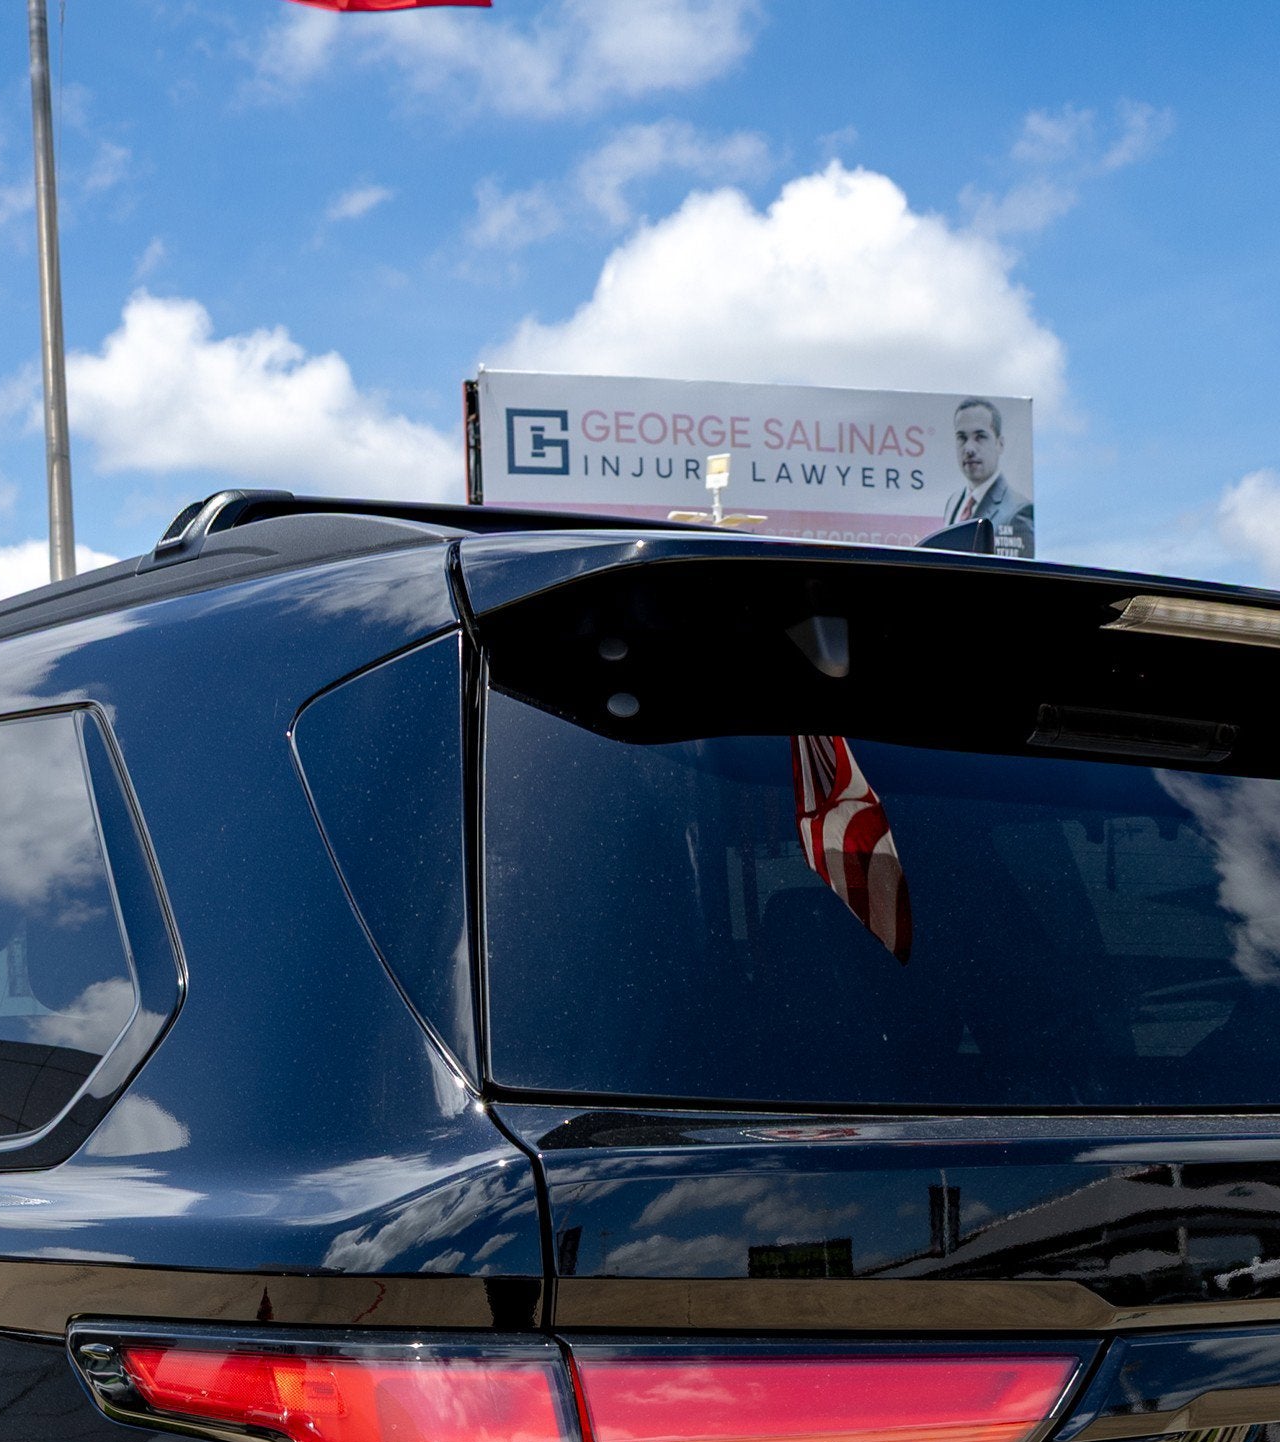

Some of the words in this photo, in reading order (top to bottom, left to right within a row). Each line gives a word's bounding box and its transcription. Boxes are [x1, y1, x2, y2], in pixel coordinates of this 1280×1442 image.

[581, 409, 751, 448] GEORGE
[763, 418, 925, 457] SALINAS
[583, 455, 702, 480] INJUR
[752, 461, 924, 490] LAWYERS
[993, 536, 1025, 549] NTONIO,
